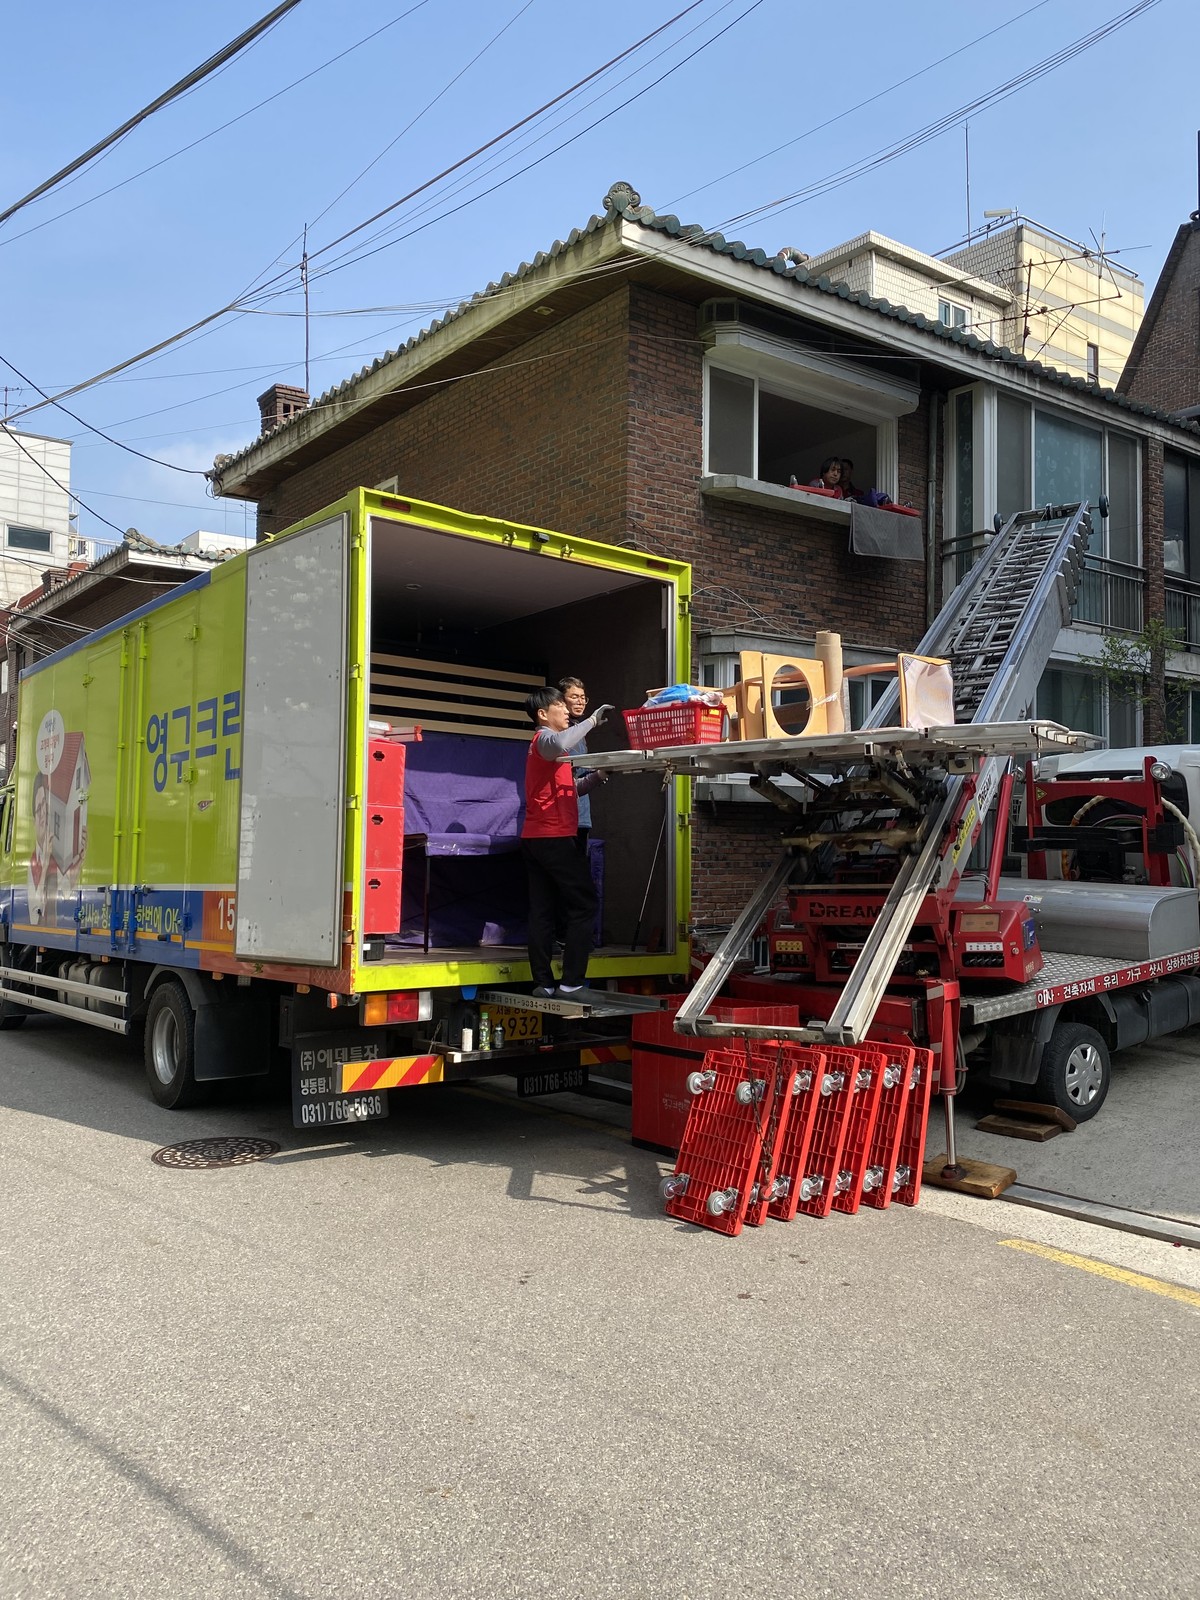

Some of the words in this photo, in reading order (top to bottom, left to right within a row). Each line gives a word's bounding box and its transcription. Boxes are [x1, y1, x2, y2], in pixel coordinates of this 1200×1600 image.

[134, 904, 162, 935] 한번에
[164, 907, 180, 934] OK
[1063, 978, 1095, 1000] 건축자재
[1103, 974, 1119, 988] 유리
[1126, 968, 1142, 982] 가구
